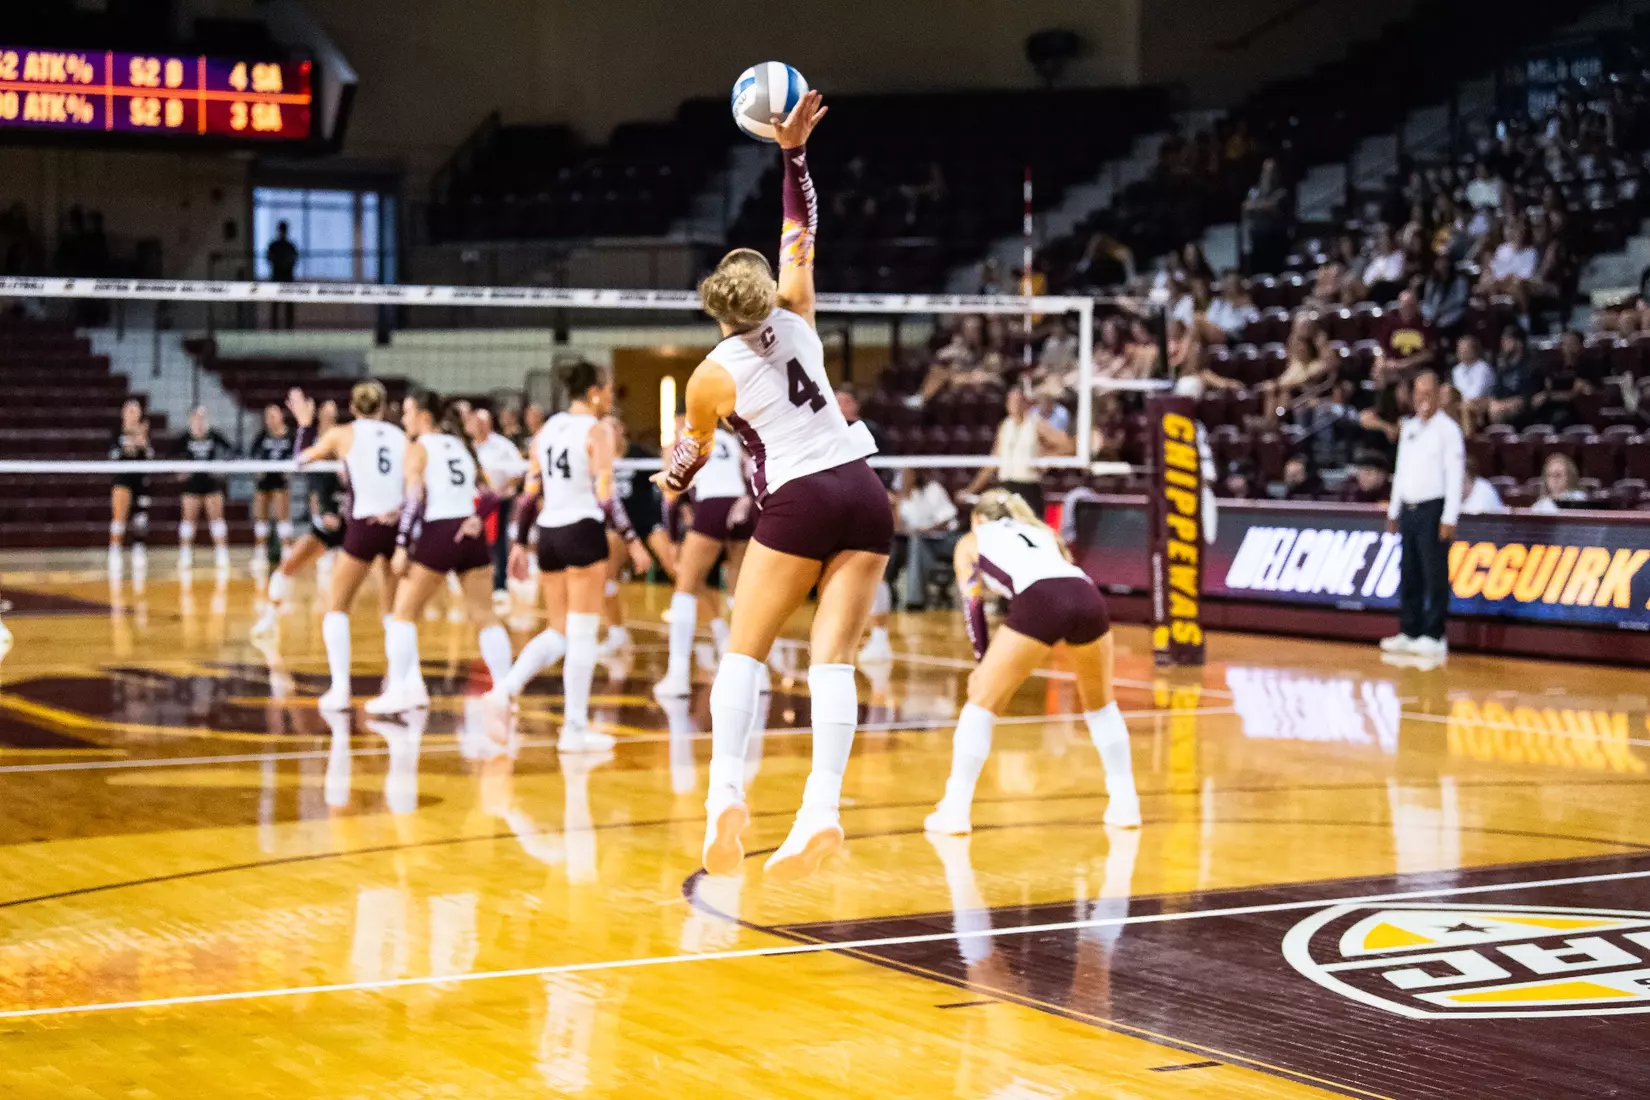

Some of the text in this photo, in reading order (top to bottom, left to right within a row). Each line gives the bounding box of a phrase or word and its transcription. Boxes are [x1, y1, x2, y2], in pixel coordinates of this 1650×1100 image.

[0, 50, 94, 83] 2 ATK%
[229, 61, 248, 91] 4
[23, 90, 94, 123] ATK%
[230, 101, 248, 130] 3
[760, 325, 776, 349] C
[786, 356, 827, 414] 4
[377, 447, 392, 474] 6
[447, 459, 466, 486] 5
[546, 445, 572, 479] 14
[1018, 533, 1039, 548] 1
[1162, 412, 1202, 646] CHIPPEWAS
[1225, 526, 1379, 596] WELCOME
[1361, 532, 1402, 598] TO
[1381, 931, 1650, 990] AC
